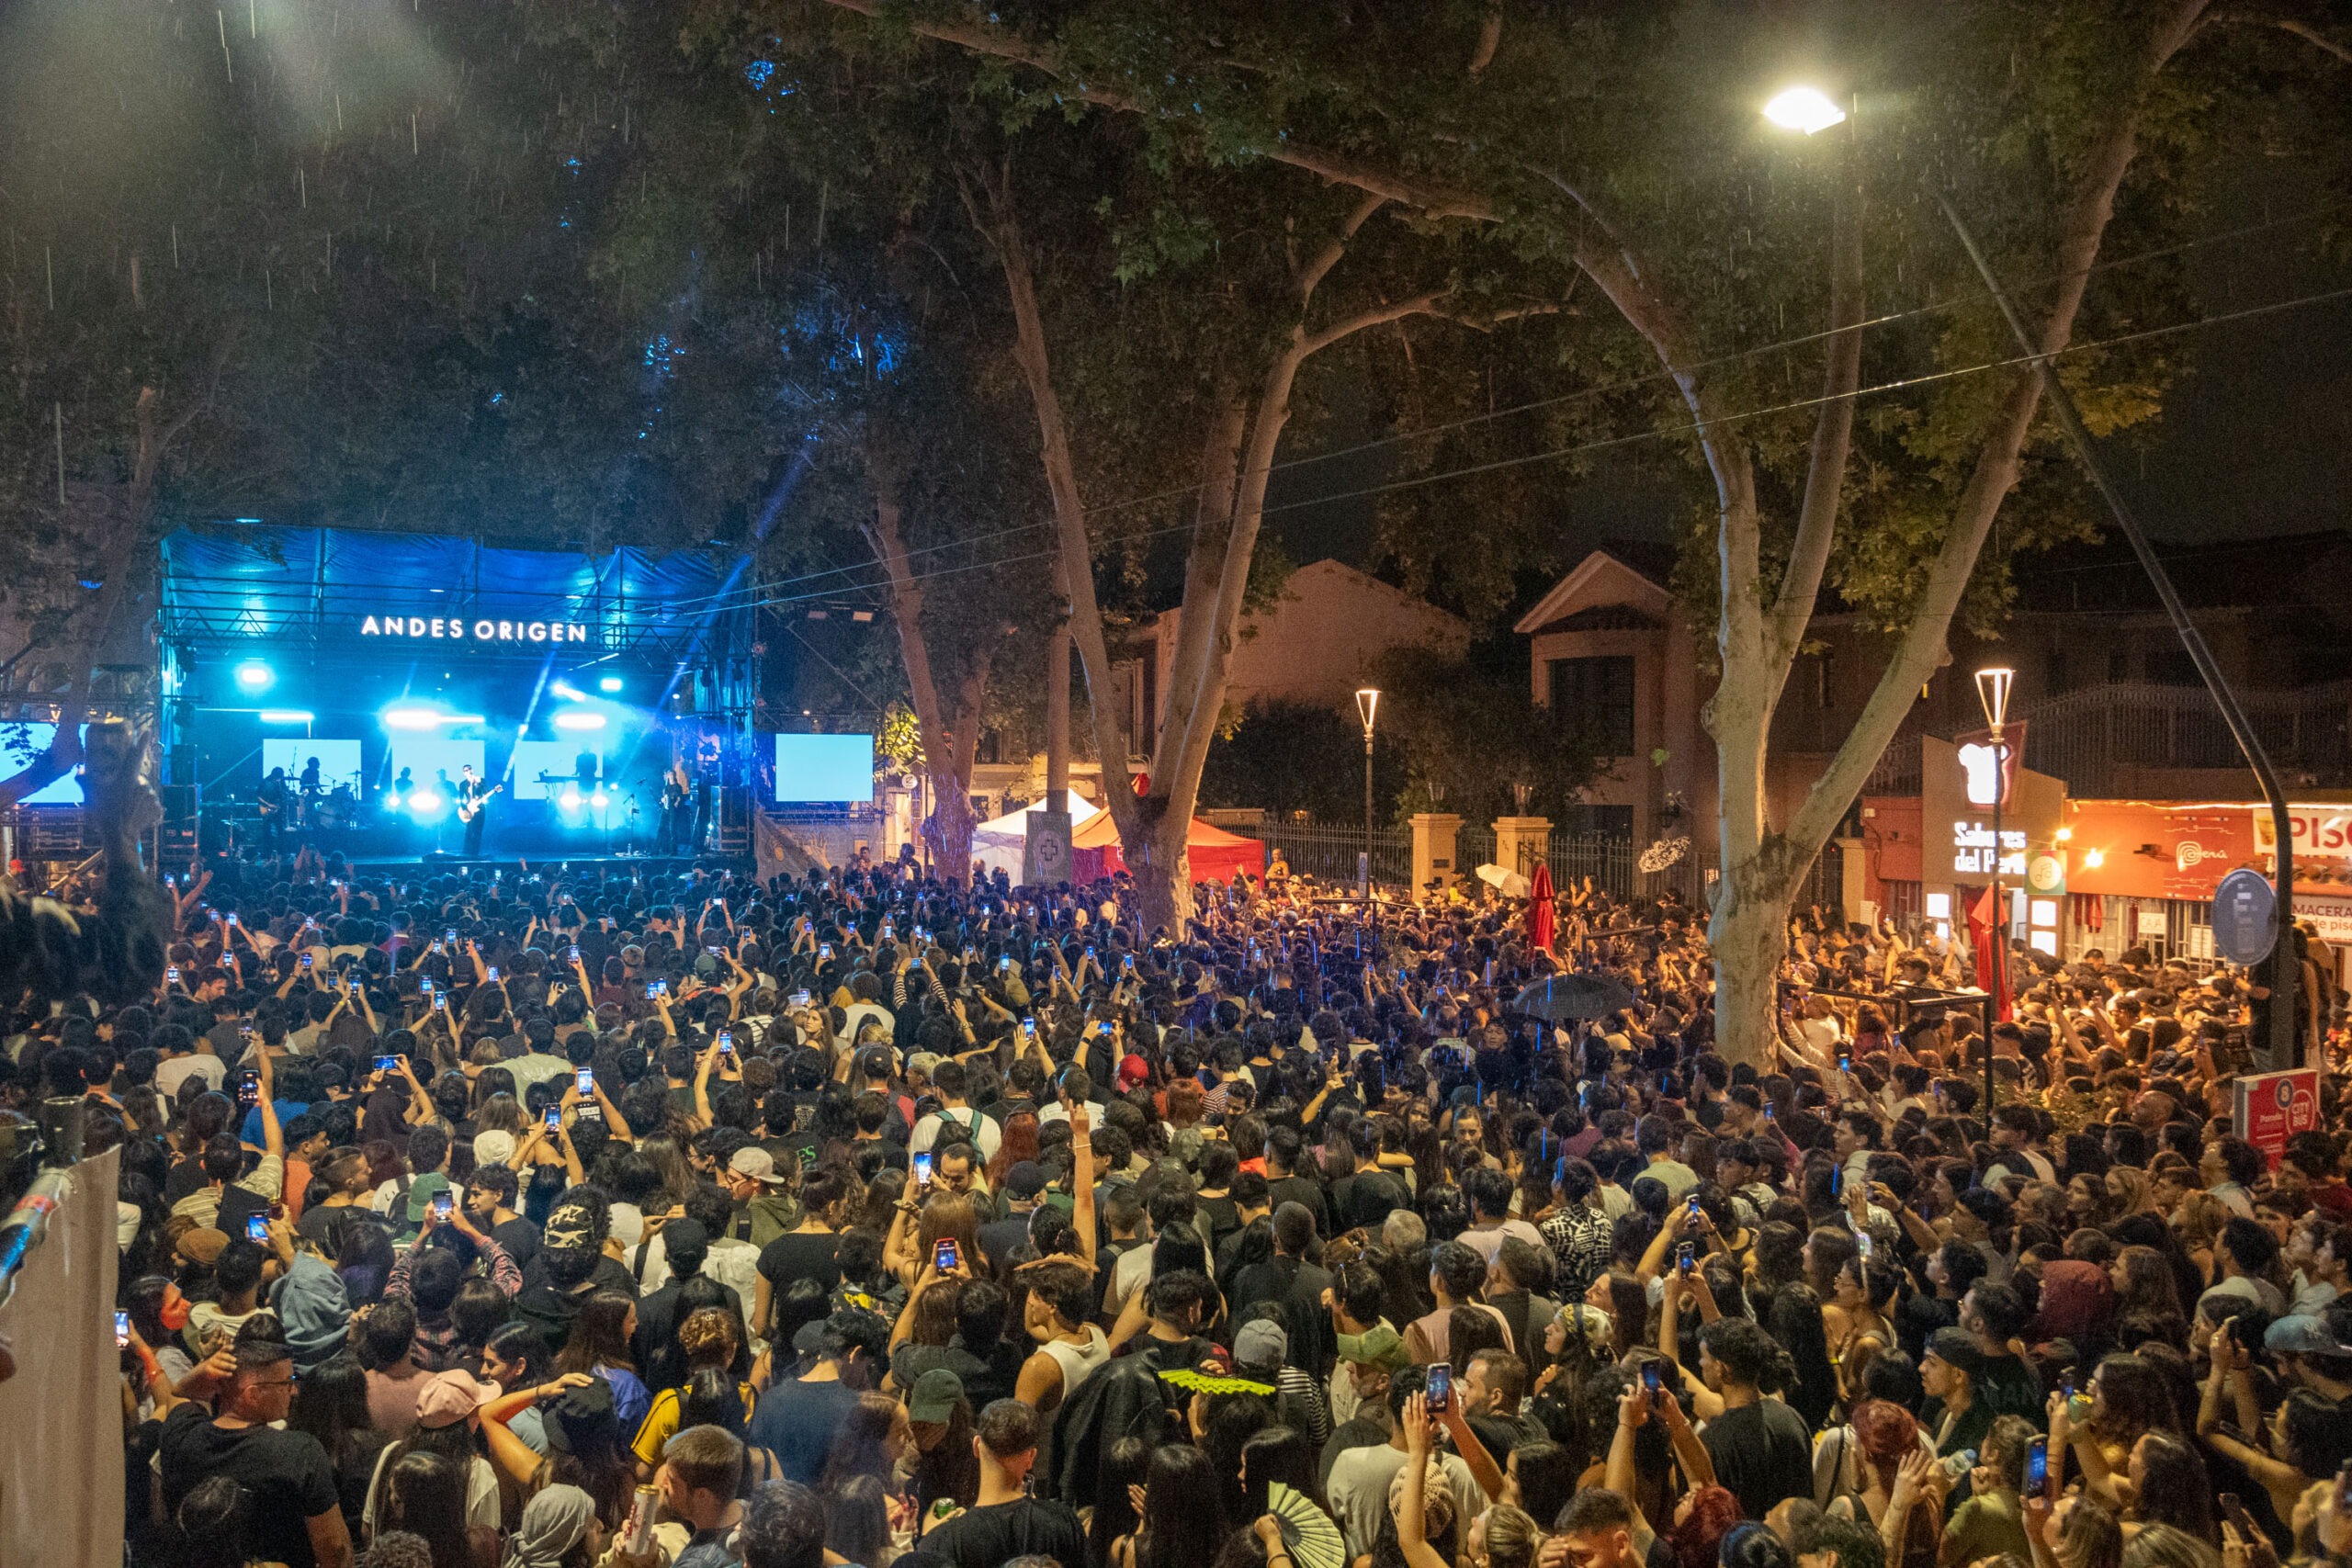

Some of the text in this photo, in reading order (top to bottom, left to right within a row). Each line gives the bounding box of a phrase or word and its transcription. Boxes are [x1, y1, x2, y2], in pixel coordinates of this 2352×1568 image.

[361, 615, 586, 642] ANDES ORIGEN
[1954, 822, 2026, 849] Sabores
[2289, 817, 2352, 849] PIS
[1954, 849, 1980, 873] del
[2330, 919, 2352, 932] pis
